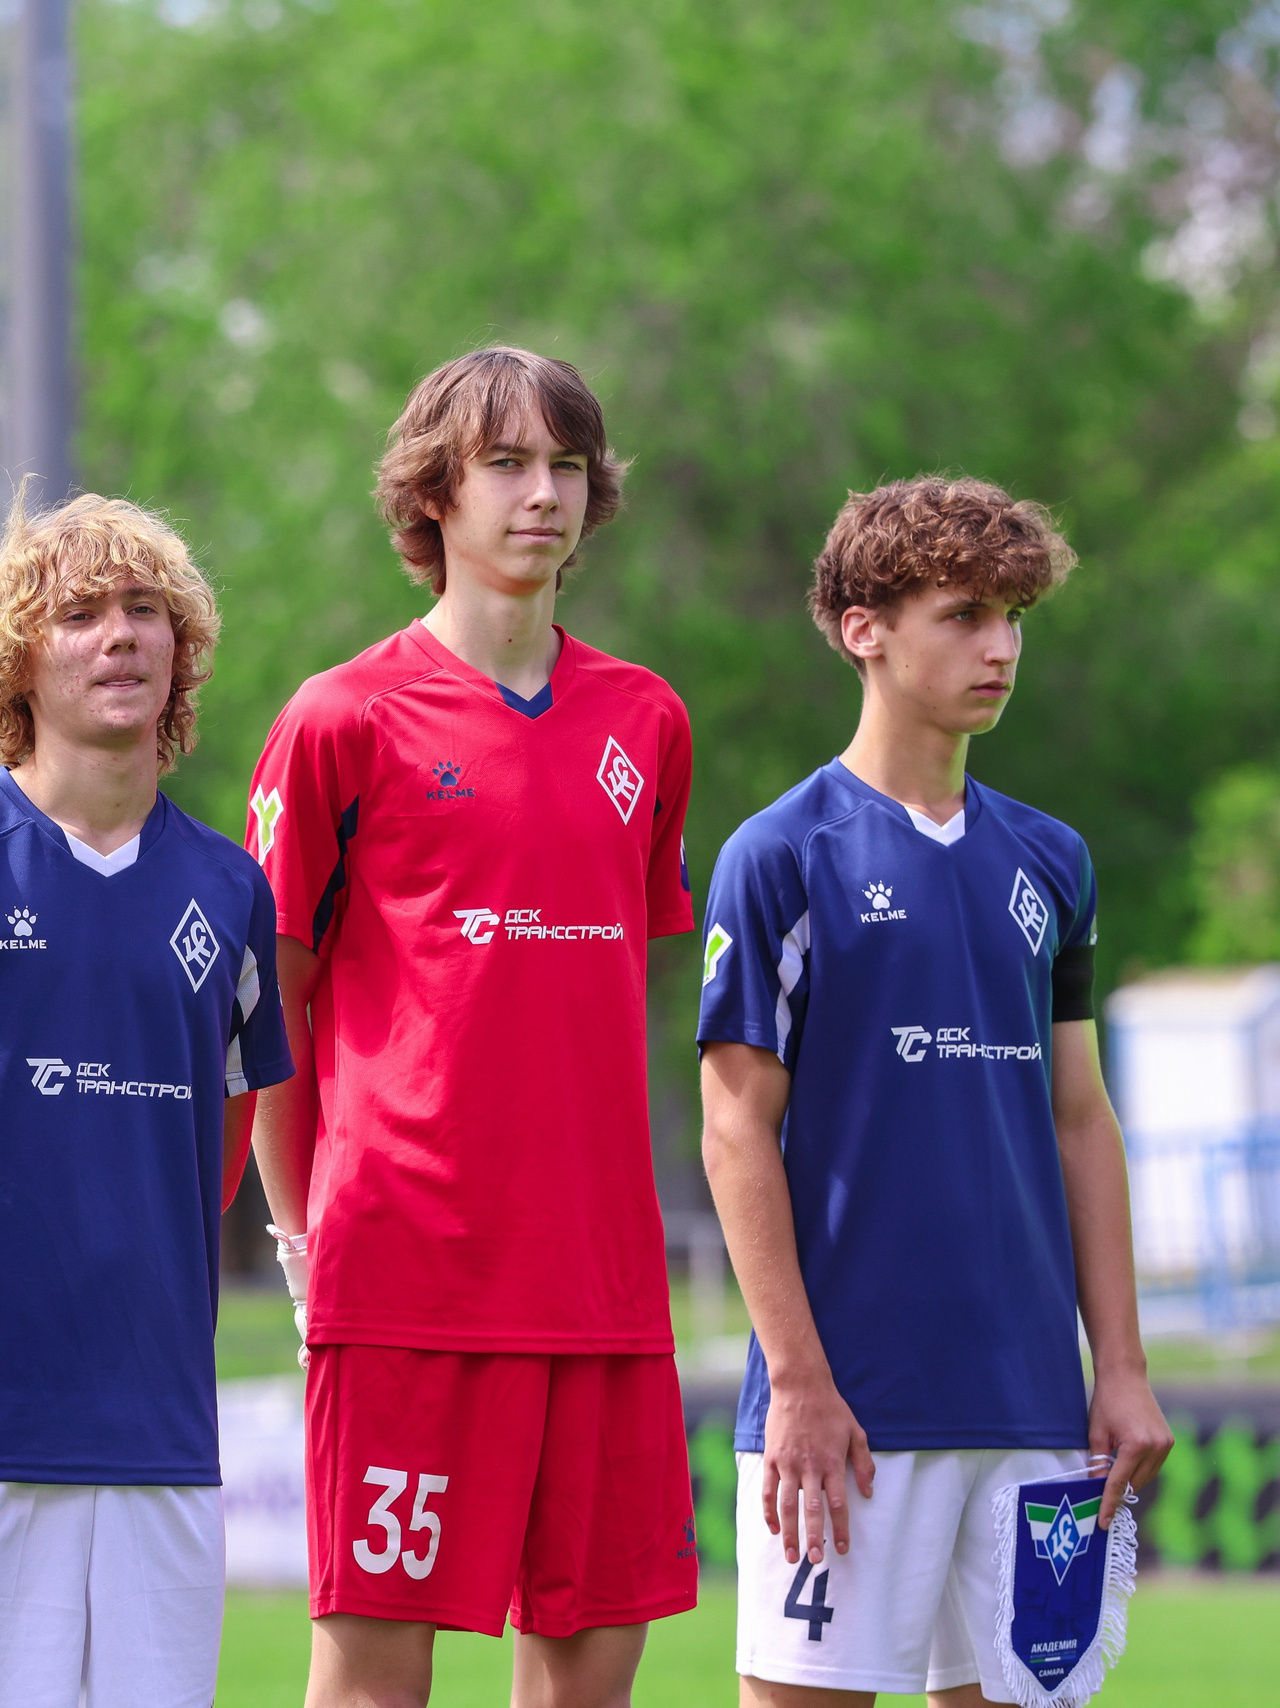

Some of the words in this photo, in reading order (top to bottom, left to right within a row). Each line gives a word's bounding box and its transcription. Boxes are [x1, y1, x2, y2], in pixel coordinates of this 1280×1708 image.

[426, 787, 476, 800] KELME
[504, 908, 542, 924] ДСК
[860, 908, 907, 924] KELME
[504, 922, 624, 940] ТРАНССТРОЙ
[936, 1026, 971, 1043] ДСК
[76, 1062, 111, 1077] ДСК
[352, 1465, 449, 1580] 35
[783, 1538, 834, 1642] 4
[1031, 1639, 1077, 1653] АКАДЕМИЯ
[1038, 1667, 1065, 1677] САМАРА
